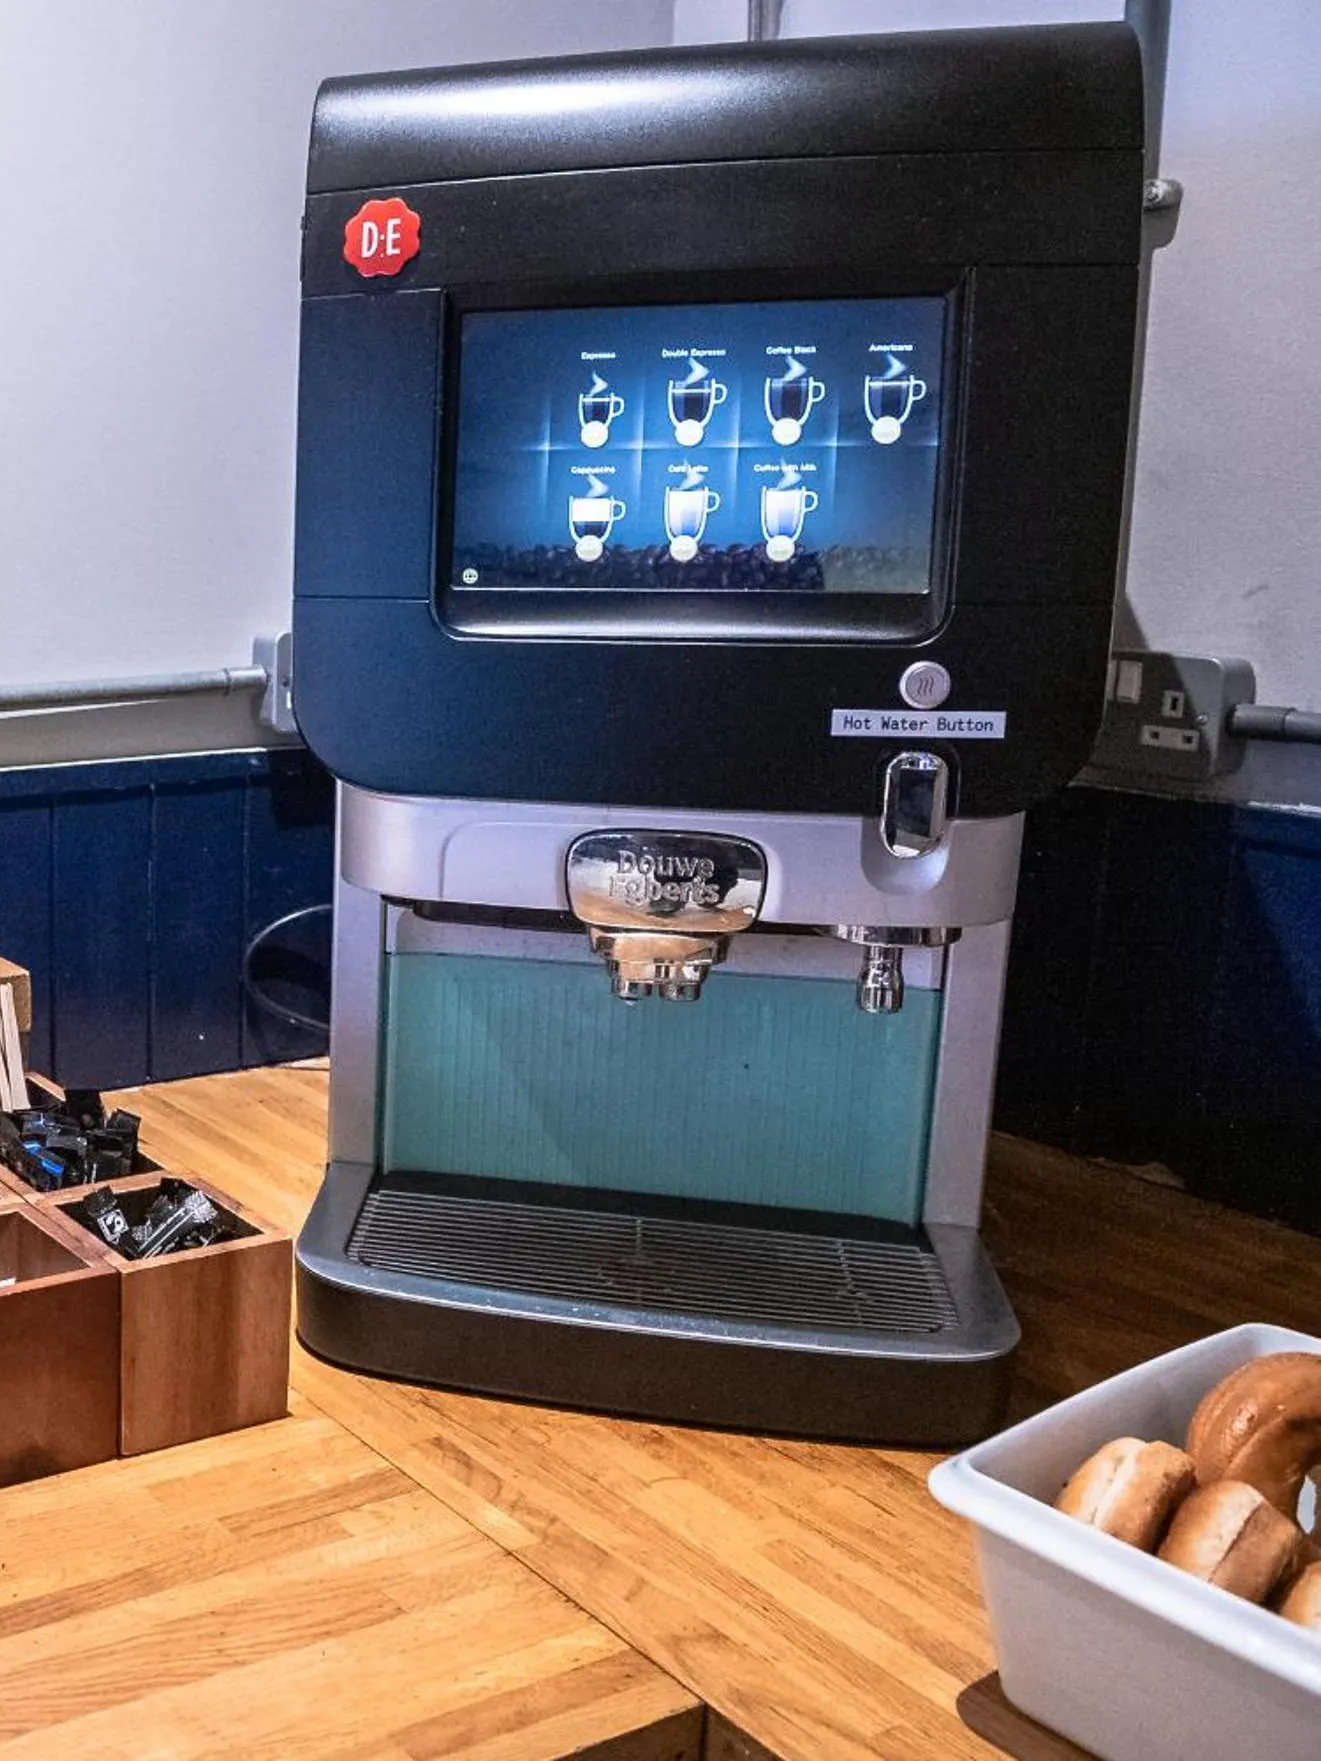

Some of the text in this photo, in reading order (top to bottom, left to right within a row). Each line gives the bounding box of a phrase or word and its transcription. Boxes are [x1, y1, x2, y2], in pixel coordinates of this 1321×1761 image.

[661, 348, 688, 358] Double
[843, 715, 994, 732] Hot Water Button
[617, 849, 715, 878] Douwe
